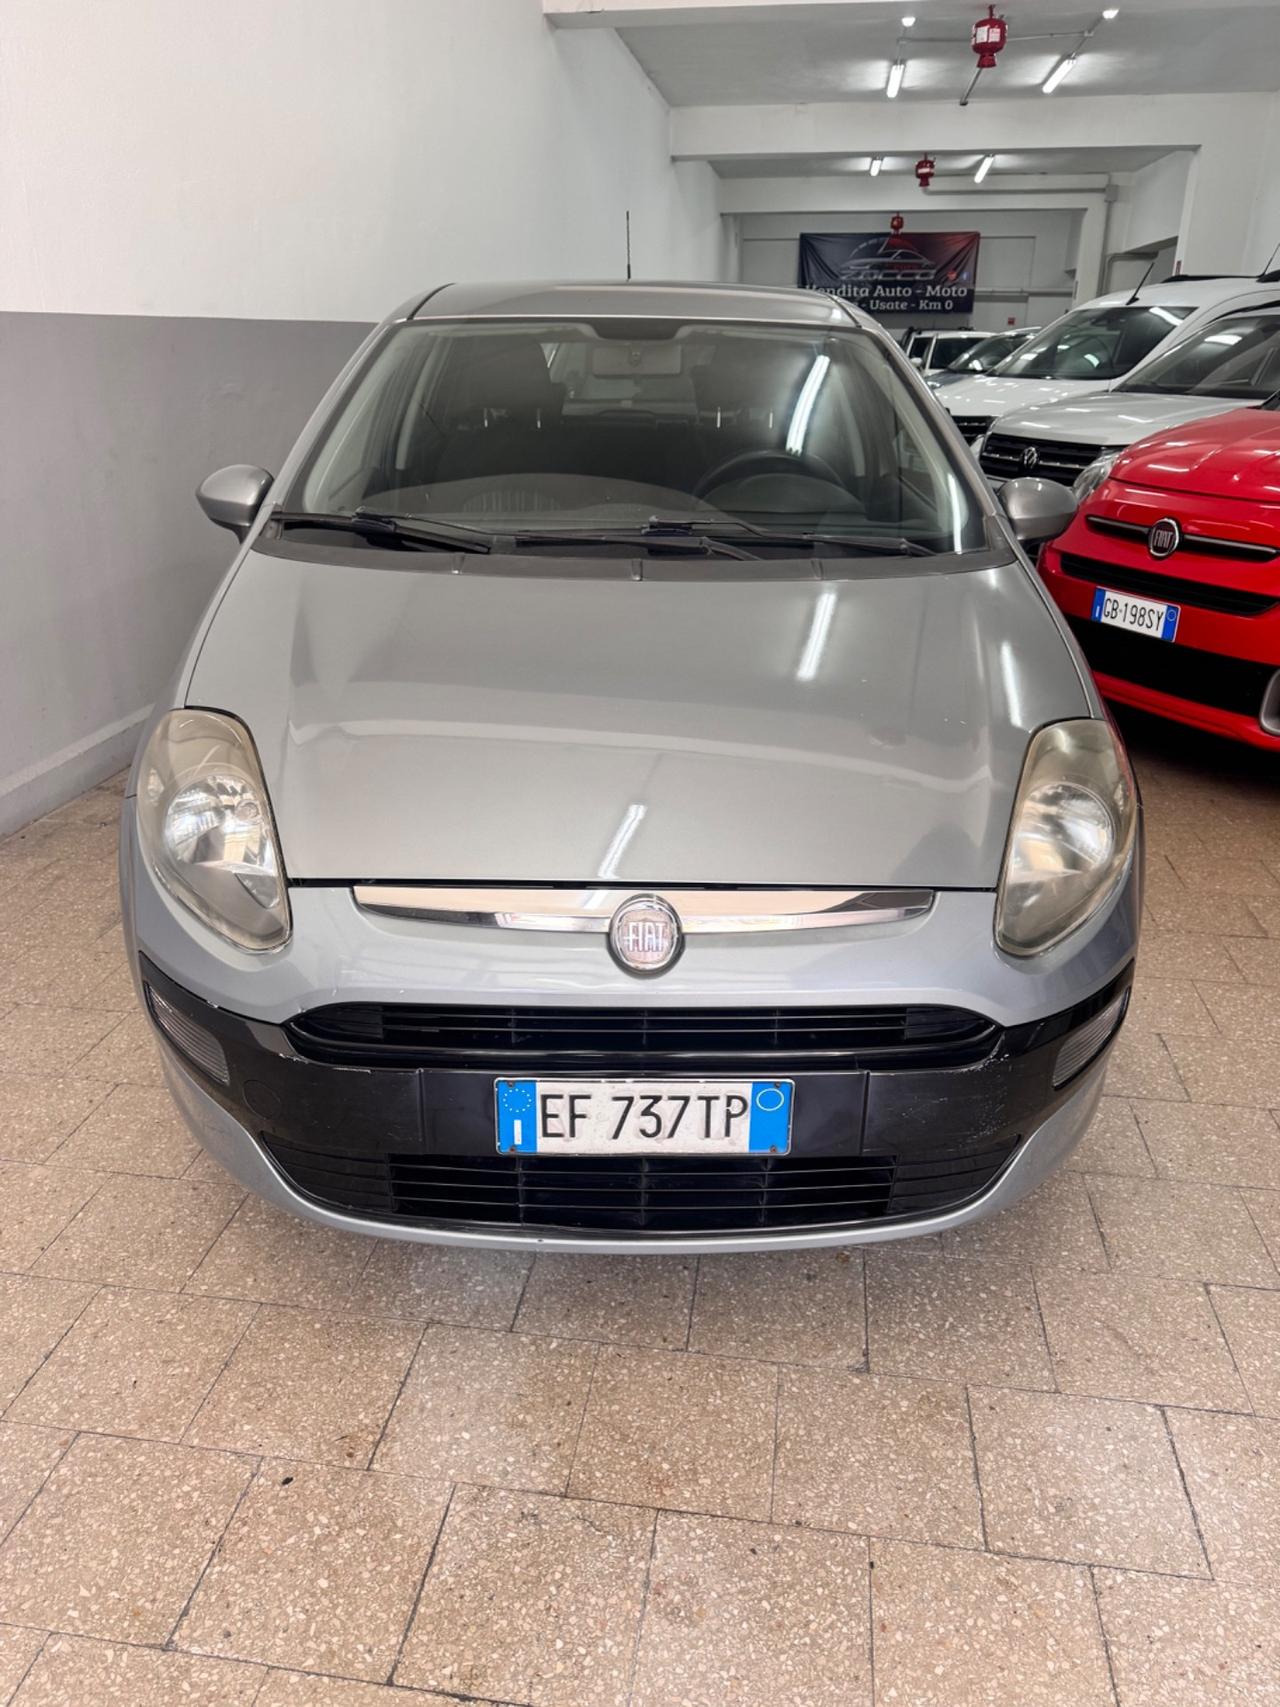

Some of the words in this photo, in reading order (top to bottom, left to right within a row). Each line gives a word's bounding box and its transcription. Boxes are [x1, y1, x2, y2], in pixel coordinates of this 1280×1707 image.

[873, 285, 913, 298] Auto
[926, 285, 968, 298] Moto
[869, 300, 908, 311] Usate
[919, 300, 941, 311] Km
[944, 300, 954, 311] 0
[1153, 529, 1173, 548] FIAT
[627, 920, 667, 952] FIAT
[540, 1093, 592, 1139] EF
[611, 1094, 749, 1140] 737TP
